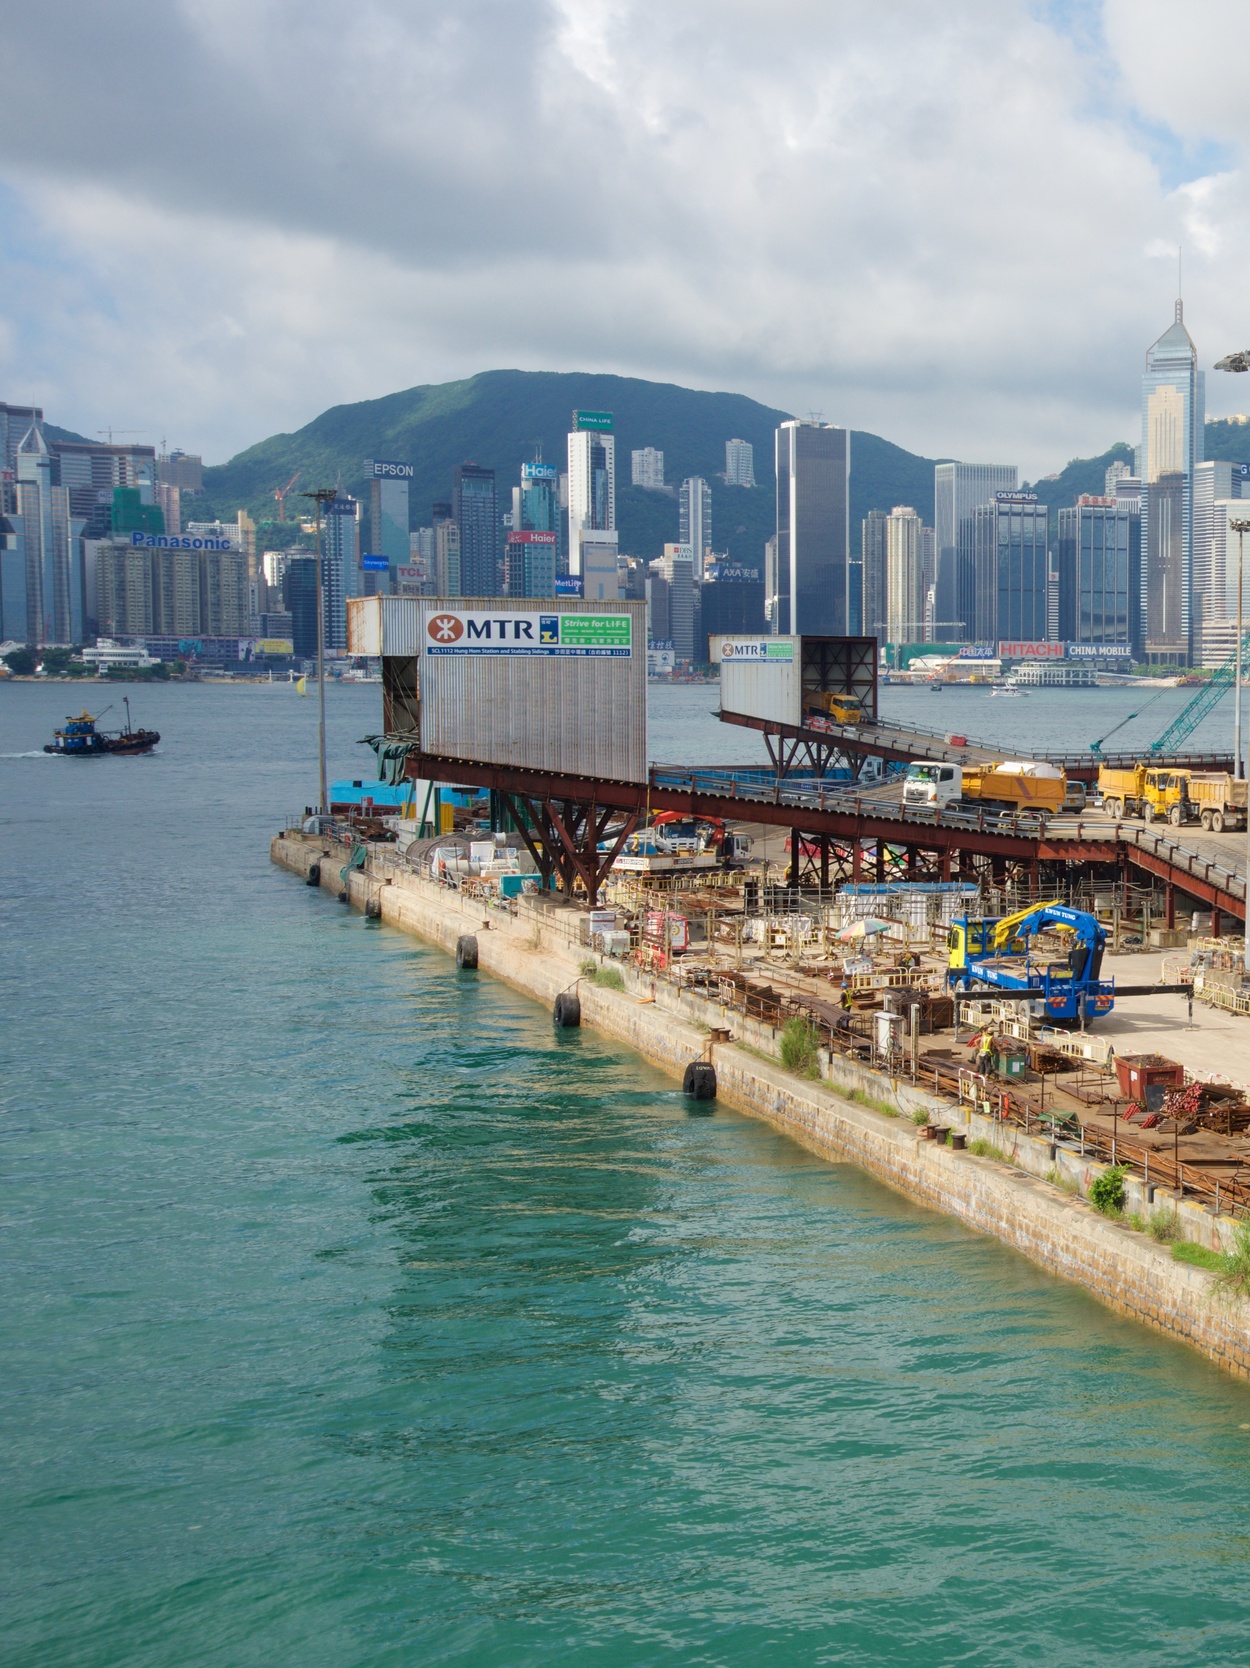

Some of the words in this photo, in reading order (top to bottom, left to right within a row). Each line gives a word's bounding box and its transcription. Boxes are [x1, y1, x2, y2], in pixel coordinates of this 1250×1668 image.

[374, 463, 414, 477] EPSON
[525, 464, 556, 478] Haier
[996, 490, 1038, 500] OLYMPUS
[131, 531, 231, 551] Panasonic
[530, 533, 555, 543] Haier
[399, 568, 424, 577] TCL
[723, 569, 741, 577] AXA
[742, 568, 759, 578] 安盛
[564, 619, 589, 627] Strive
[467, 619, 534, 639] MTR
[735, 645, 758, 655] MTR
[1001, 645, 1063, 657] HITACHI
[1069, 646, 1097, 655] CHINA
[1099, 646, 1132, 656] MOBILE
[1045, 908, 1061, 918] KWUN
[1061, 911, 1076, 921] TUNG
[971, 964, 984, 975] KWUN
[986, 969, 998, 980] TUNG
